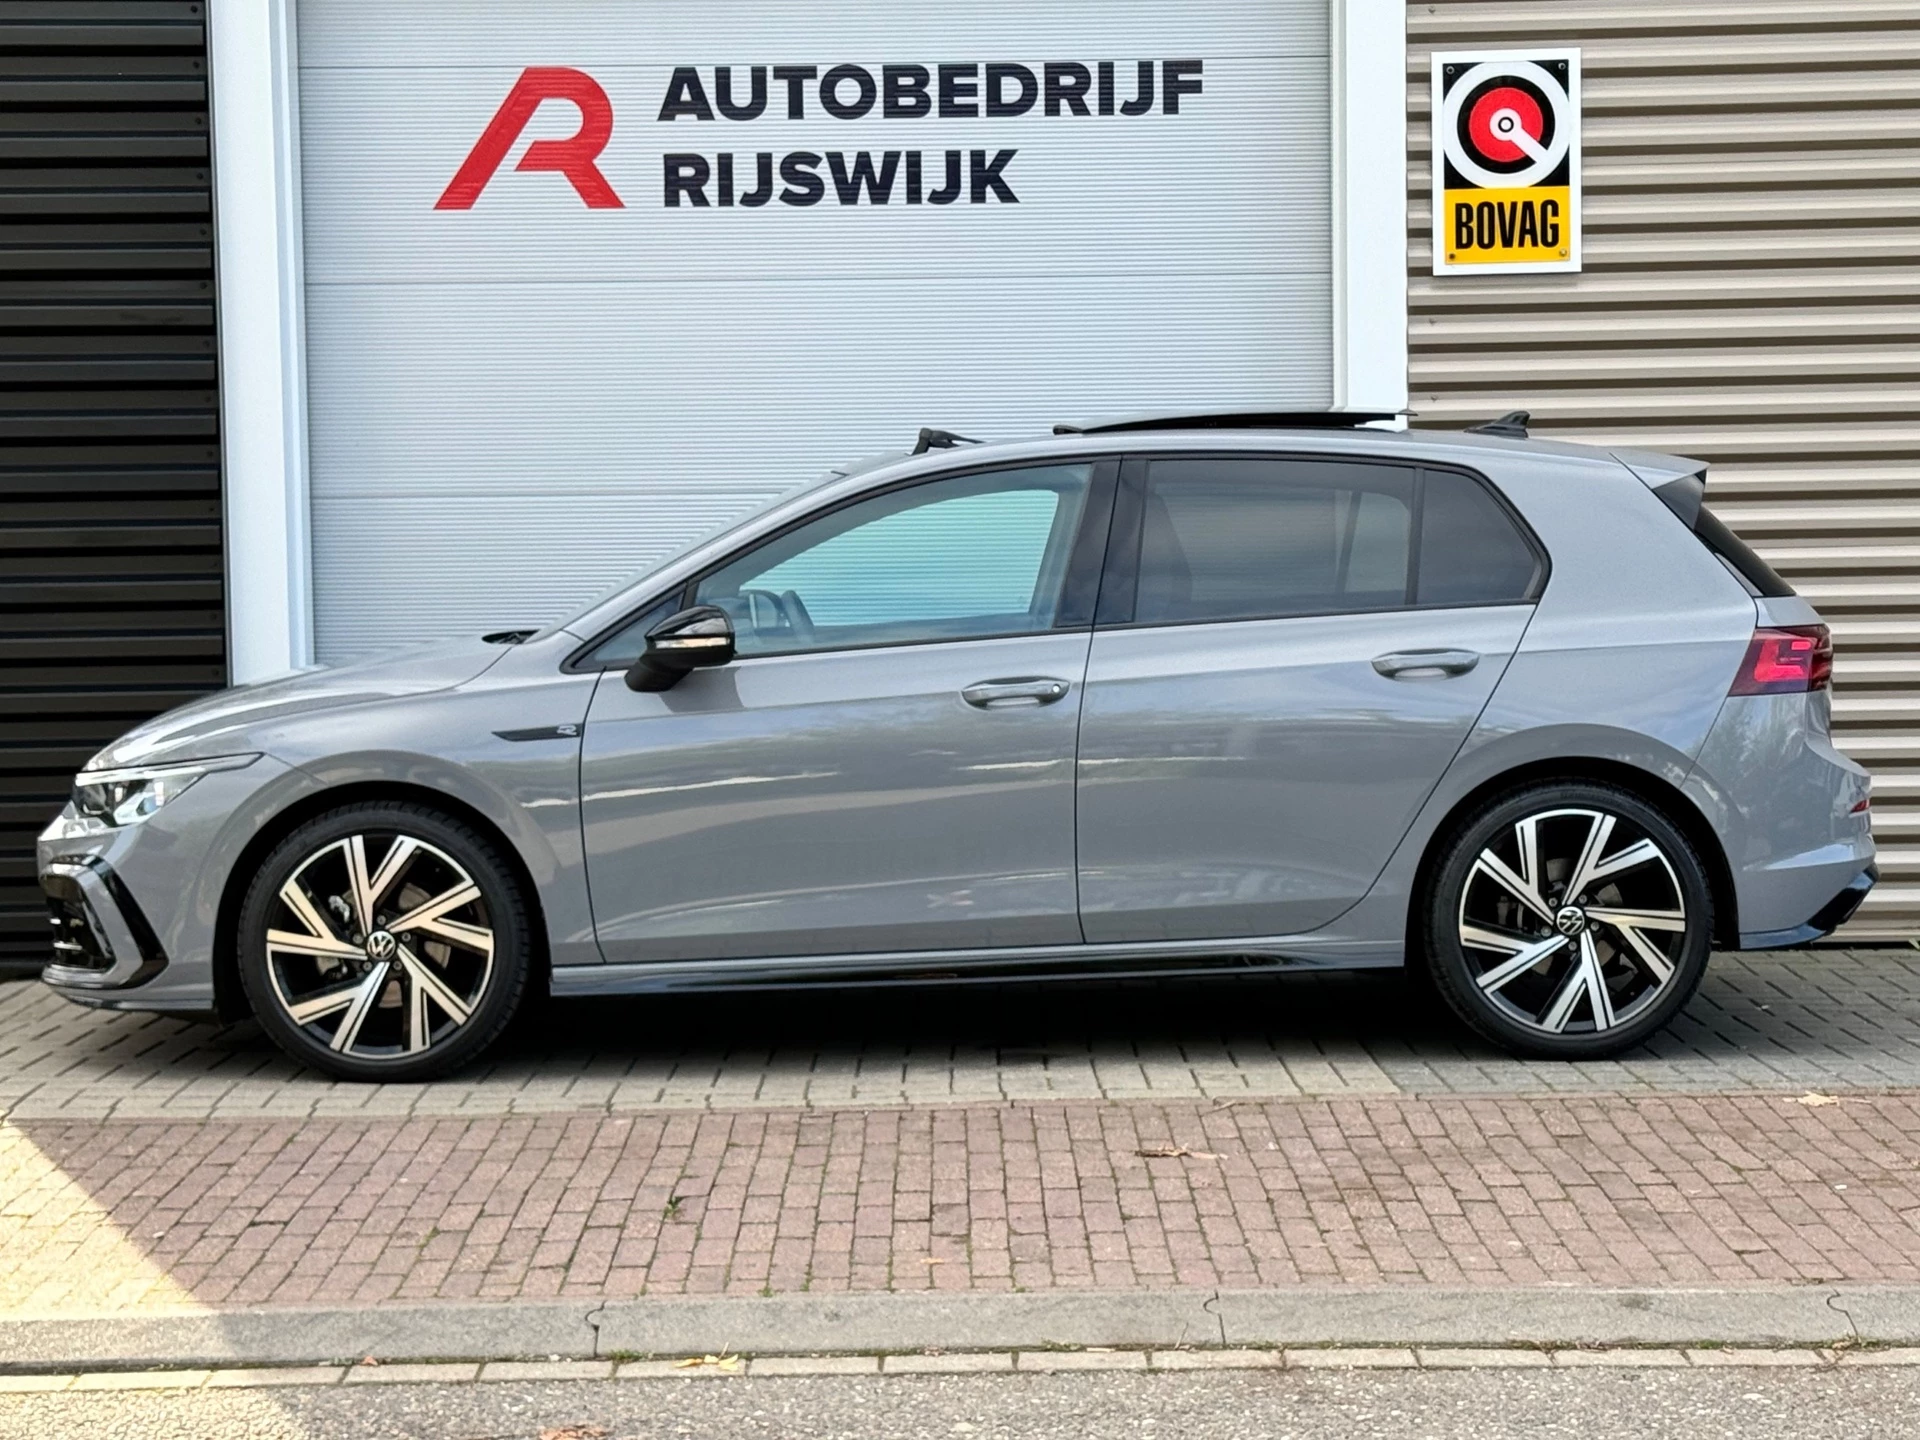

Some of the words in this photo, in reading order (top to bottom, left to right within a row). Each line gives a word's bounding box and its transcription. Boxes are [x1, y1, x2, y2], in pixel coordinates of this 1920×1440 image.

[657, 60, 1203, 121] AUTOBEDRIJF
[663, 149, 1020, 208] RIJSWIJK
[1455, 199, 1560, 250] BOVAG
